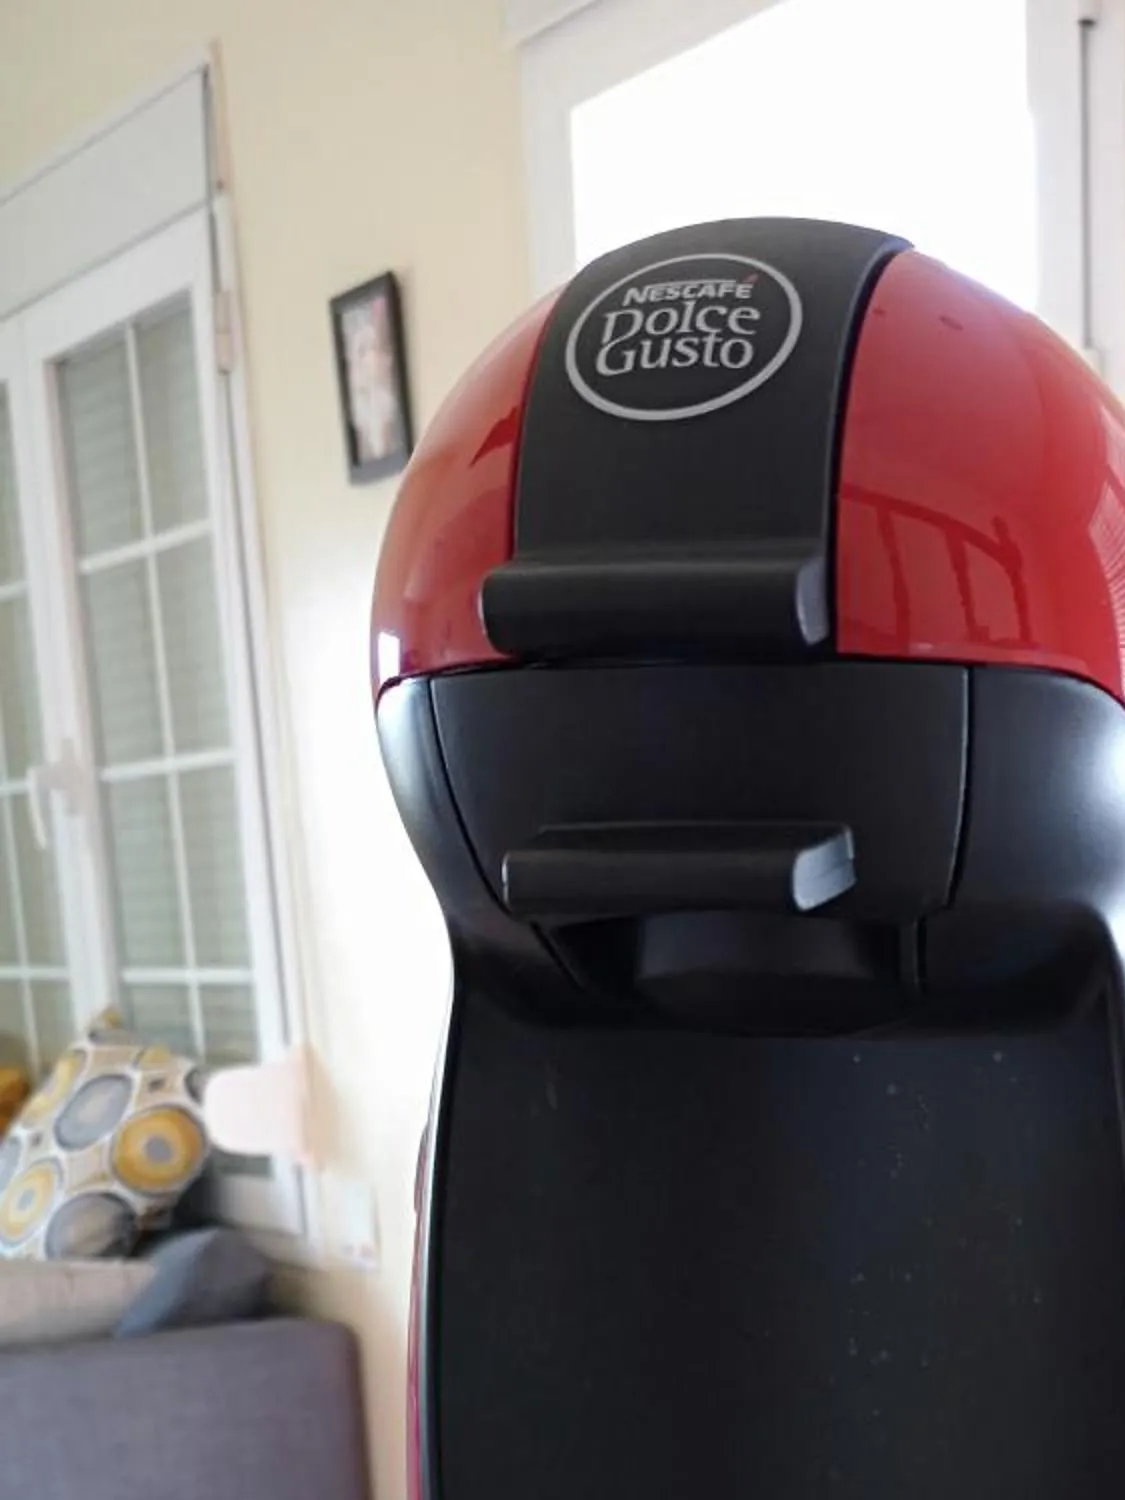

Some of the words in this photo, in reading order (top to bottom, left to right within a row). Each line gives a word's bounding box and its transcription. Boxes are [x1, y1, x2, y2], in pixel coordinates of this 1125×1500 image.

[622, 273, 759, 307] NESCAFÉ
[601, 301, 761, 345] Dolce
[596, 331, 754, 376] Gusto
